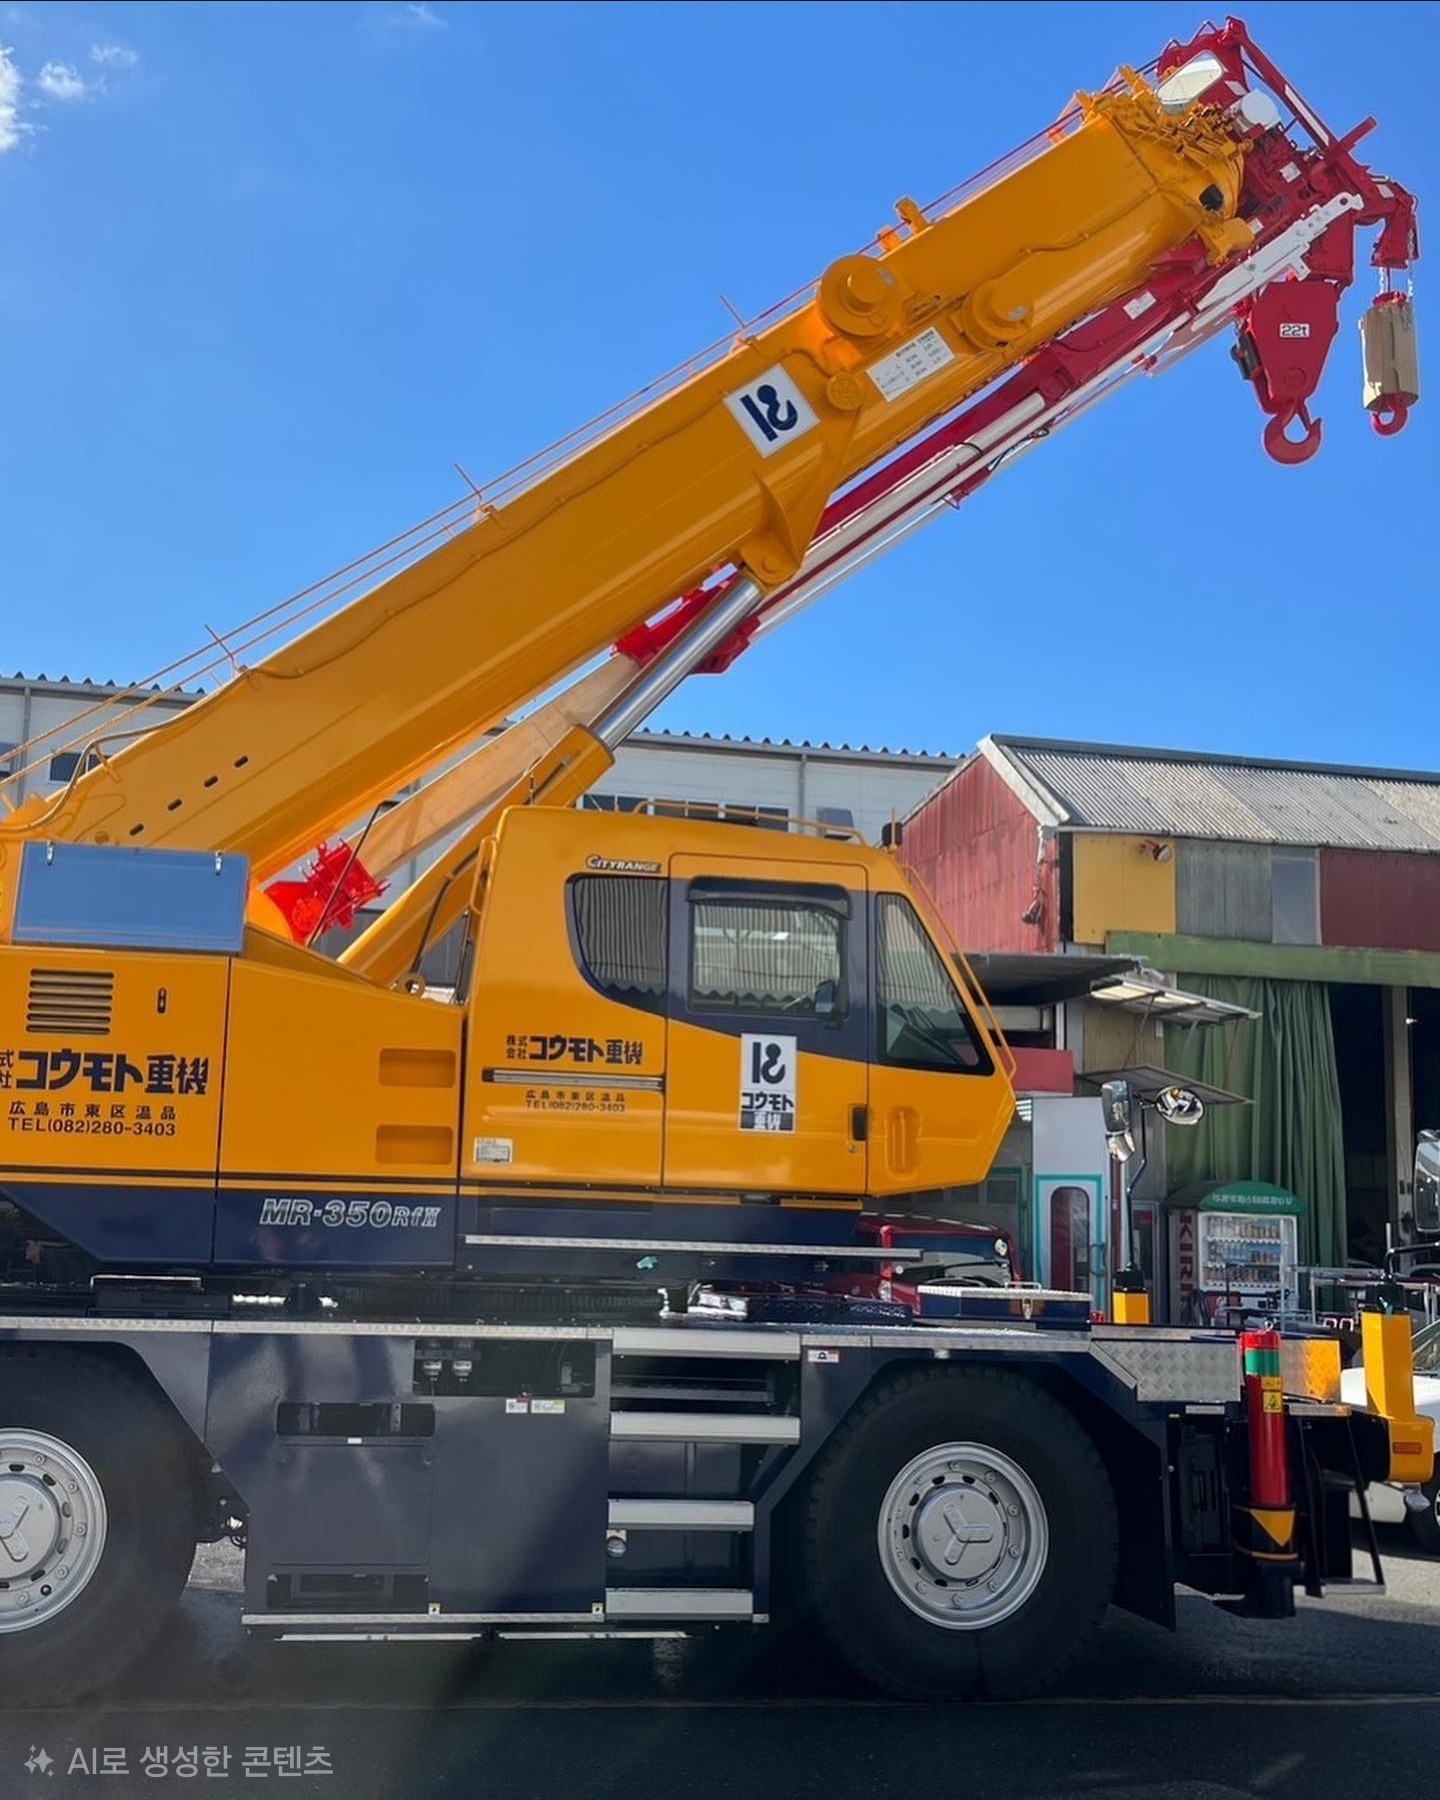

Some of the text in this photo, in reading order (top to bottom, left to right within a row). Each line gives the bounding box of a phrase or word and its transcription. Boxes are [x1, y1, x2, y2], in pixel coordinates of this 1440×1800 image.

[1282, 324, 1307, 336] 22t
[529, 1035, 642, 1064] コウモト重機
[16, 1049, 209, 1095] コウモト重機
[9, 1101, 176, 1120] 広島市東区温品
[741, 1091, 794, 1111] コウモト
[8, 1117, 176, 1136] TEL(082)280-3403
[1178, 1213, 1194, 1311] KIRI
